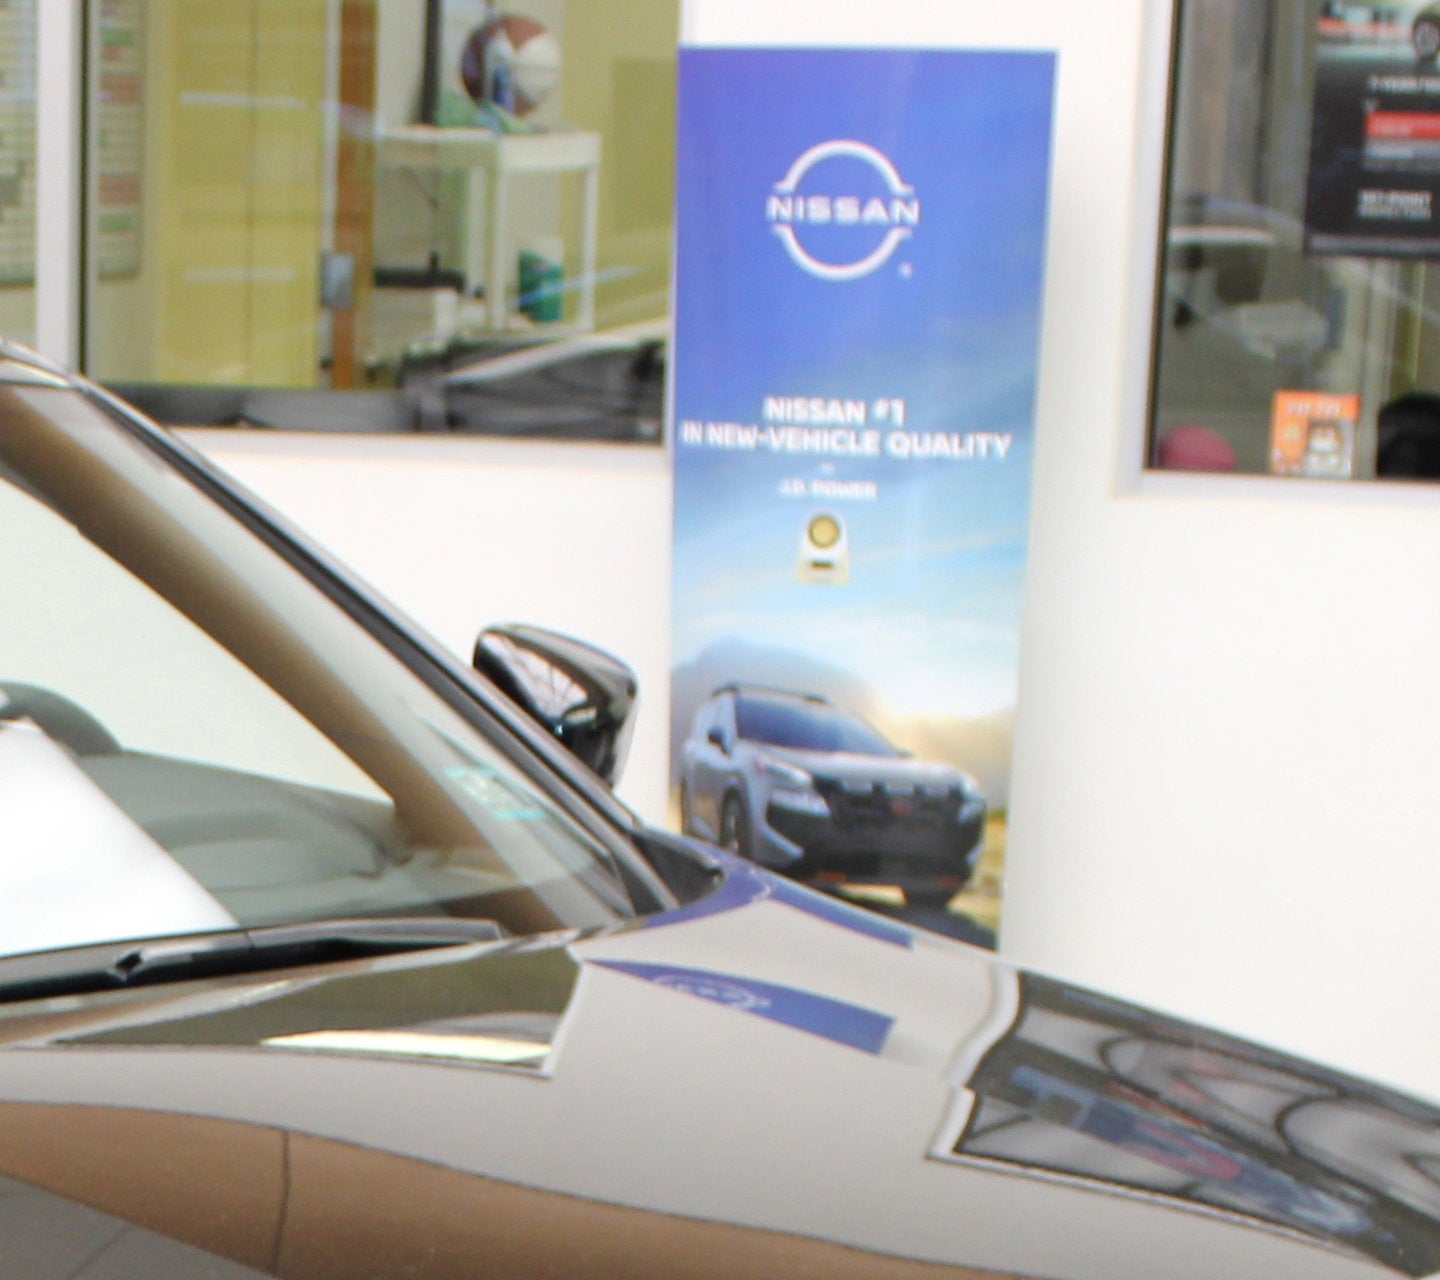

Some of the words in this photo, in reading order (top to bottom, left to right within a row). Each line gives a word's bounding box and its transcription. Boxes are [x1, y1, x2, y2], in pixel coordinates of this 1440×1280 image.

[765, 193, 921, 226] NISSAN
[762, 396, 867, 424] NISSAN
[873, 398, 907, 427] #1
[682, 420, 703, 445] IN
[707, 422, 882, 456] NEW-VEHICLE
[887, 430, 1014, 460] QUALITY
[811, 479, 880, 500] POWER
